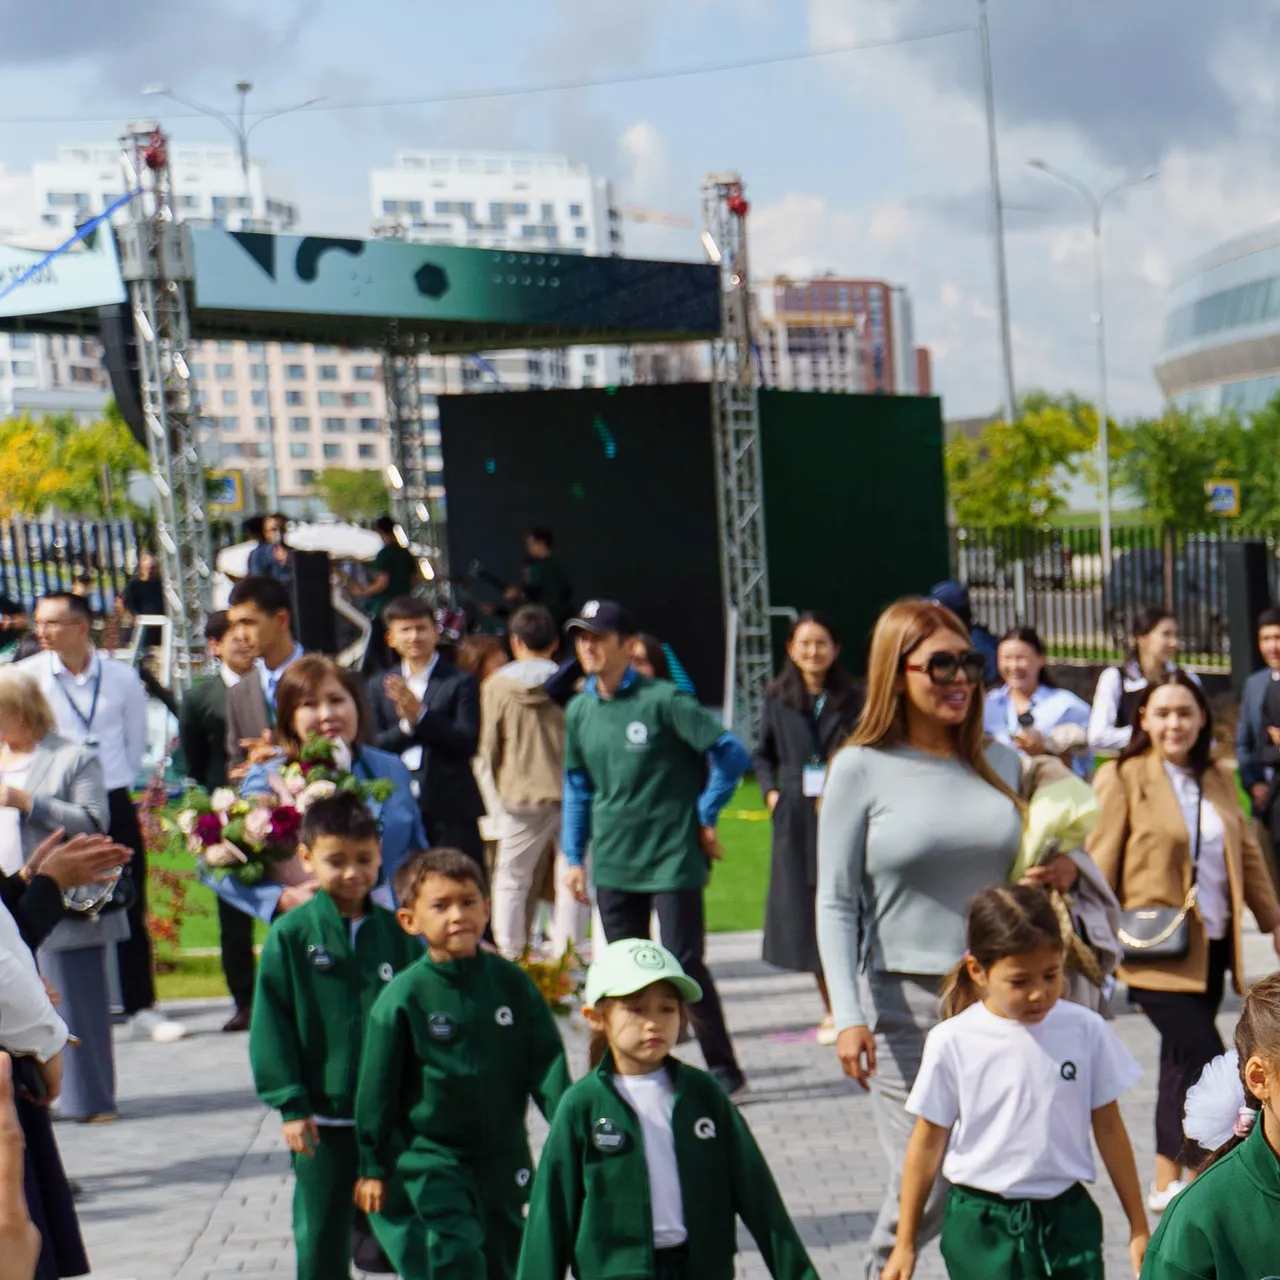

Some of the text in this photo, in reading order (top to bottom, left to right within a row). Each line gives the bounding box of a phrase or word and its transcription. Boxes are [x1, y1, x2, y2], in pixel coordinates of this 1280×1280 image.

[494, 1006, 514, 1026] Q
[1060, 1061, 1076, 1082] Q
[694, 1117, 716, 1139] Q
